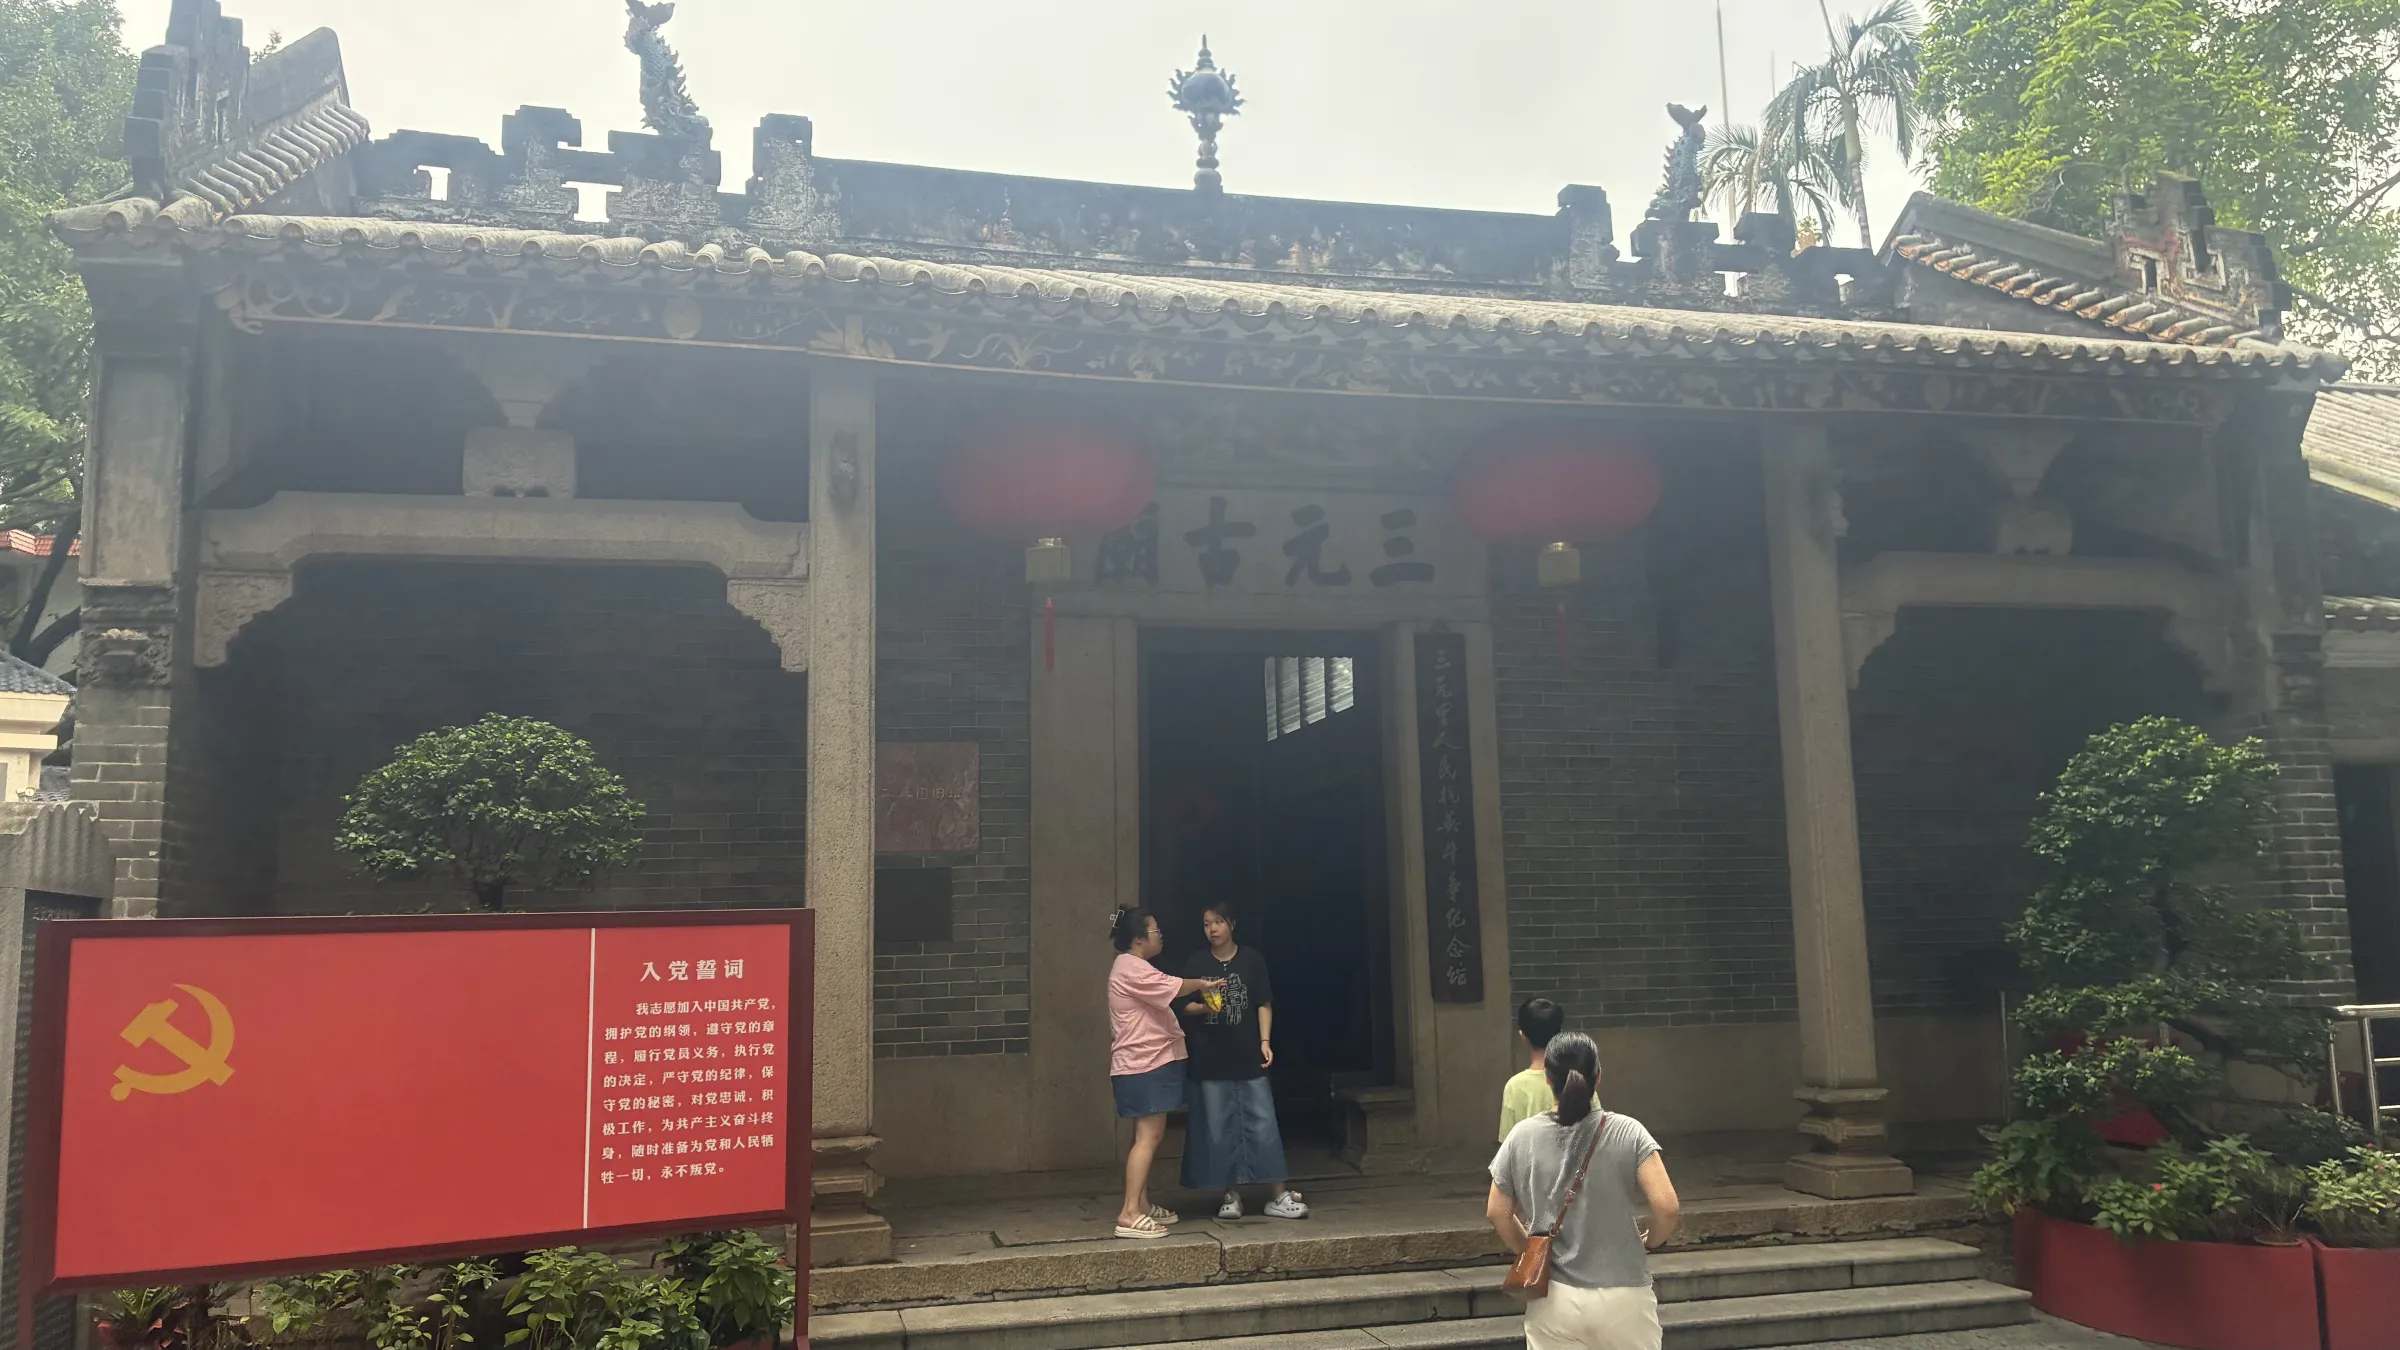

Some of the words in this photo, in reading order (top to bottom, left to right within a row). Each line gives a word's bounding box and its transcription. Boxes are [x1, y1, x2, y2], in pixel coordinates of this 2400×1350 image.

[639, 958, 745, 982] 入党誓词
[635, 997, 777, 1016] 我志愿加入中国共产党，
[604, 1019, 776, 1041] 拥护党的纲领，遵守党的章
[603, 1042, 775, 1065] 程，履行党员义务，执行党
[602, 1065, 775, 1089] 的决定，严守党的纪律，保
[602, 1088, 774, 1112] 守党的秘密，对党忠诚，积
[601, 1111, 774, 1136] 极工作，为共产主义奋斗终
[600, 1134, 774, 1160] 身，随时准备为党和人民牺
[600, 1161, 725, 1185] 牲一切，永不叛党。
